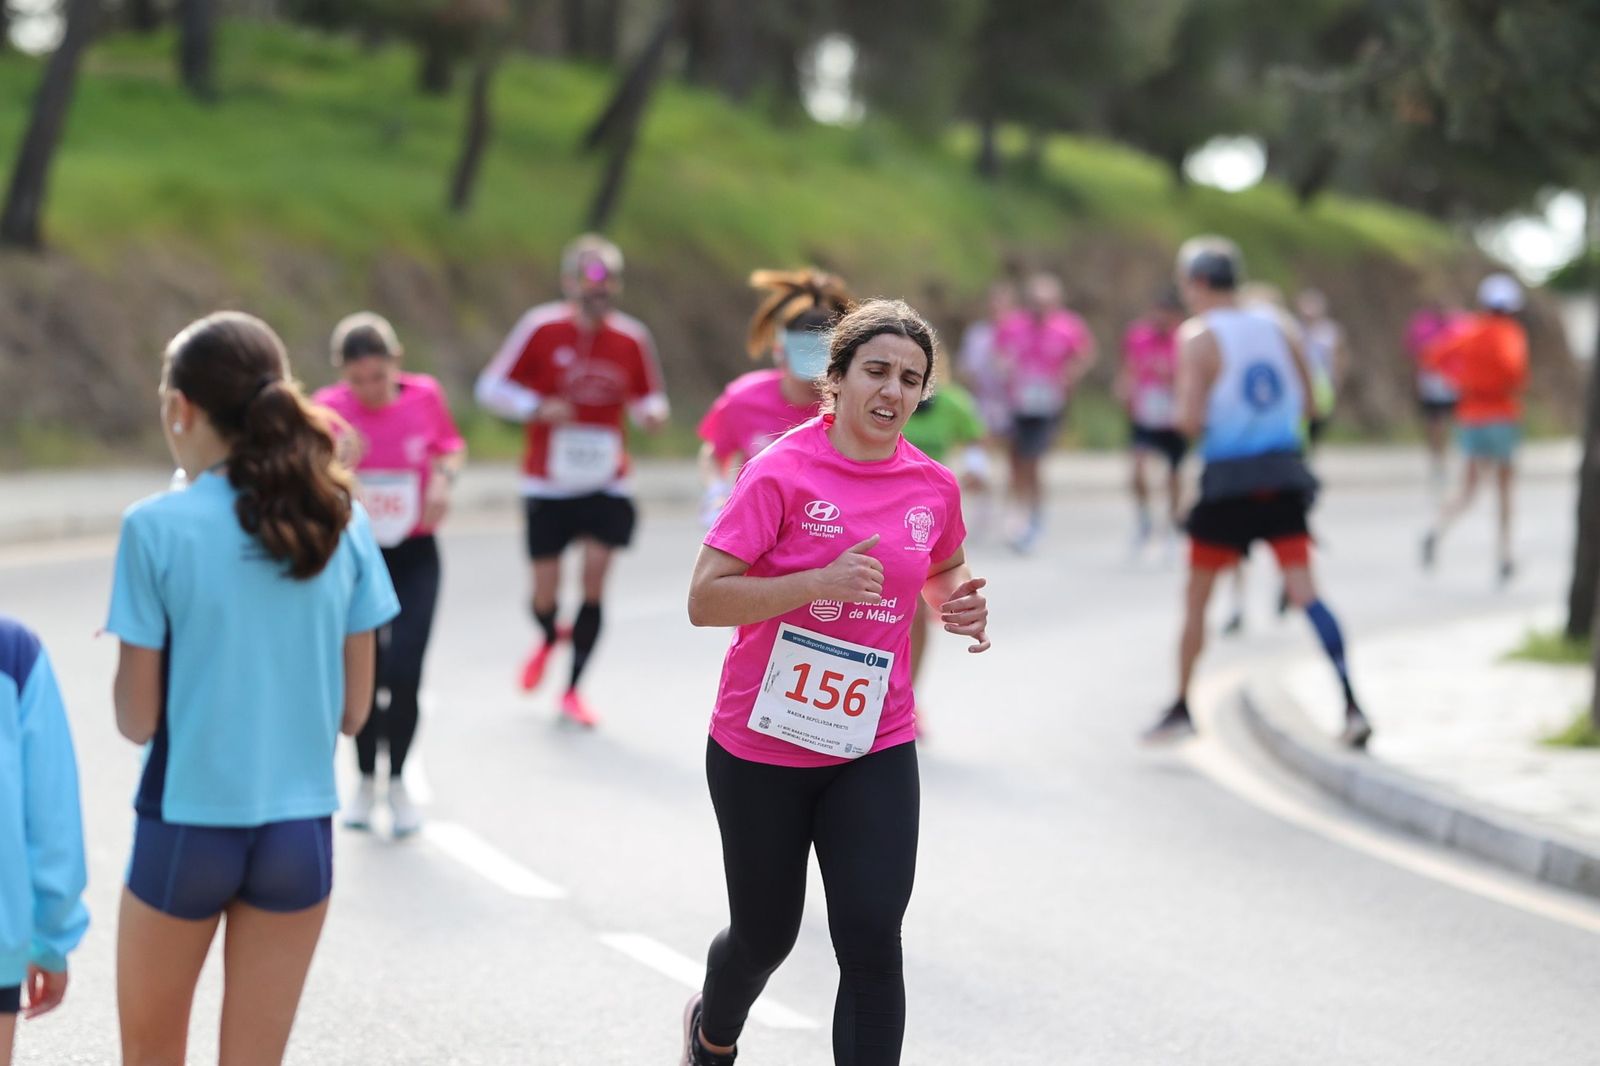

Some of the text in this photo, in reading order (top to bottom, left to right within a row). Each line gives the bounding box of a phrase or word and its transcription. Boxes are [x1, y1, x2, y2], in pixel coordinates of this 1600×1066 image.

[801, 521, 843, 534] HYUNDAI
[849, 609, 904, 624] de Mála
[784, 662, 870, 717] 156
